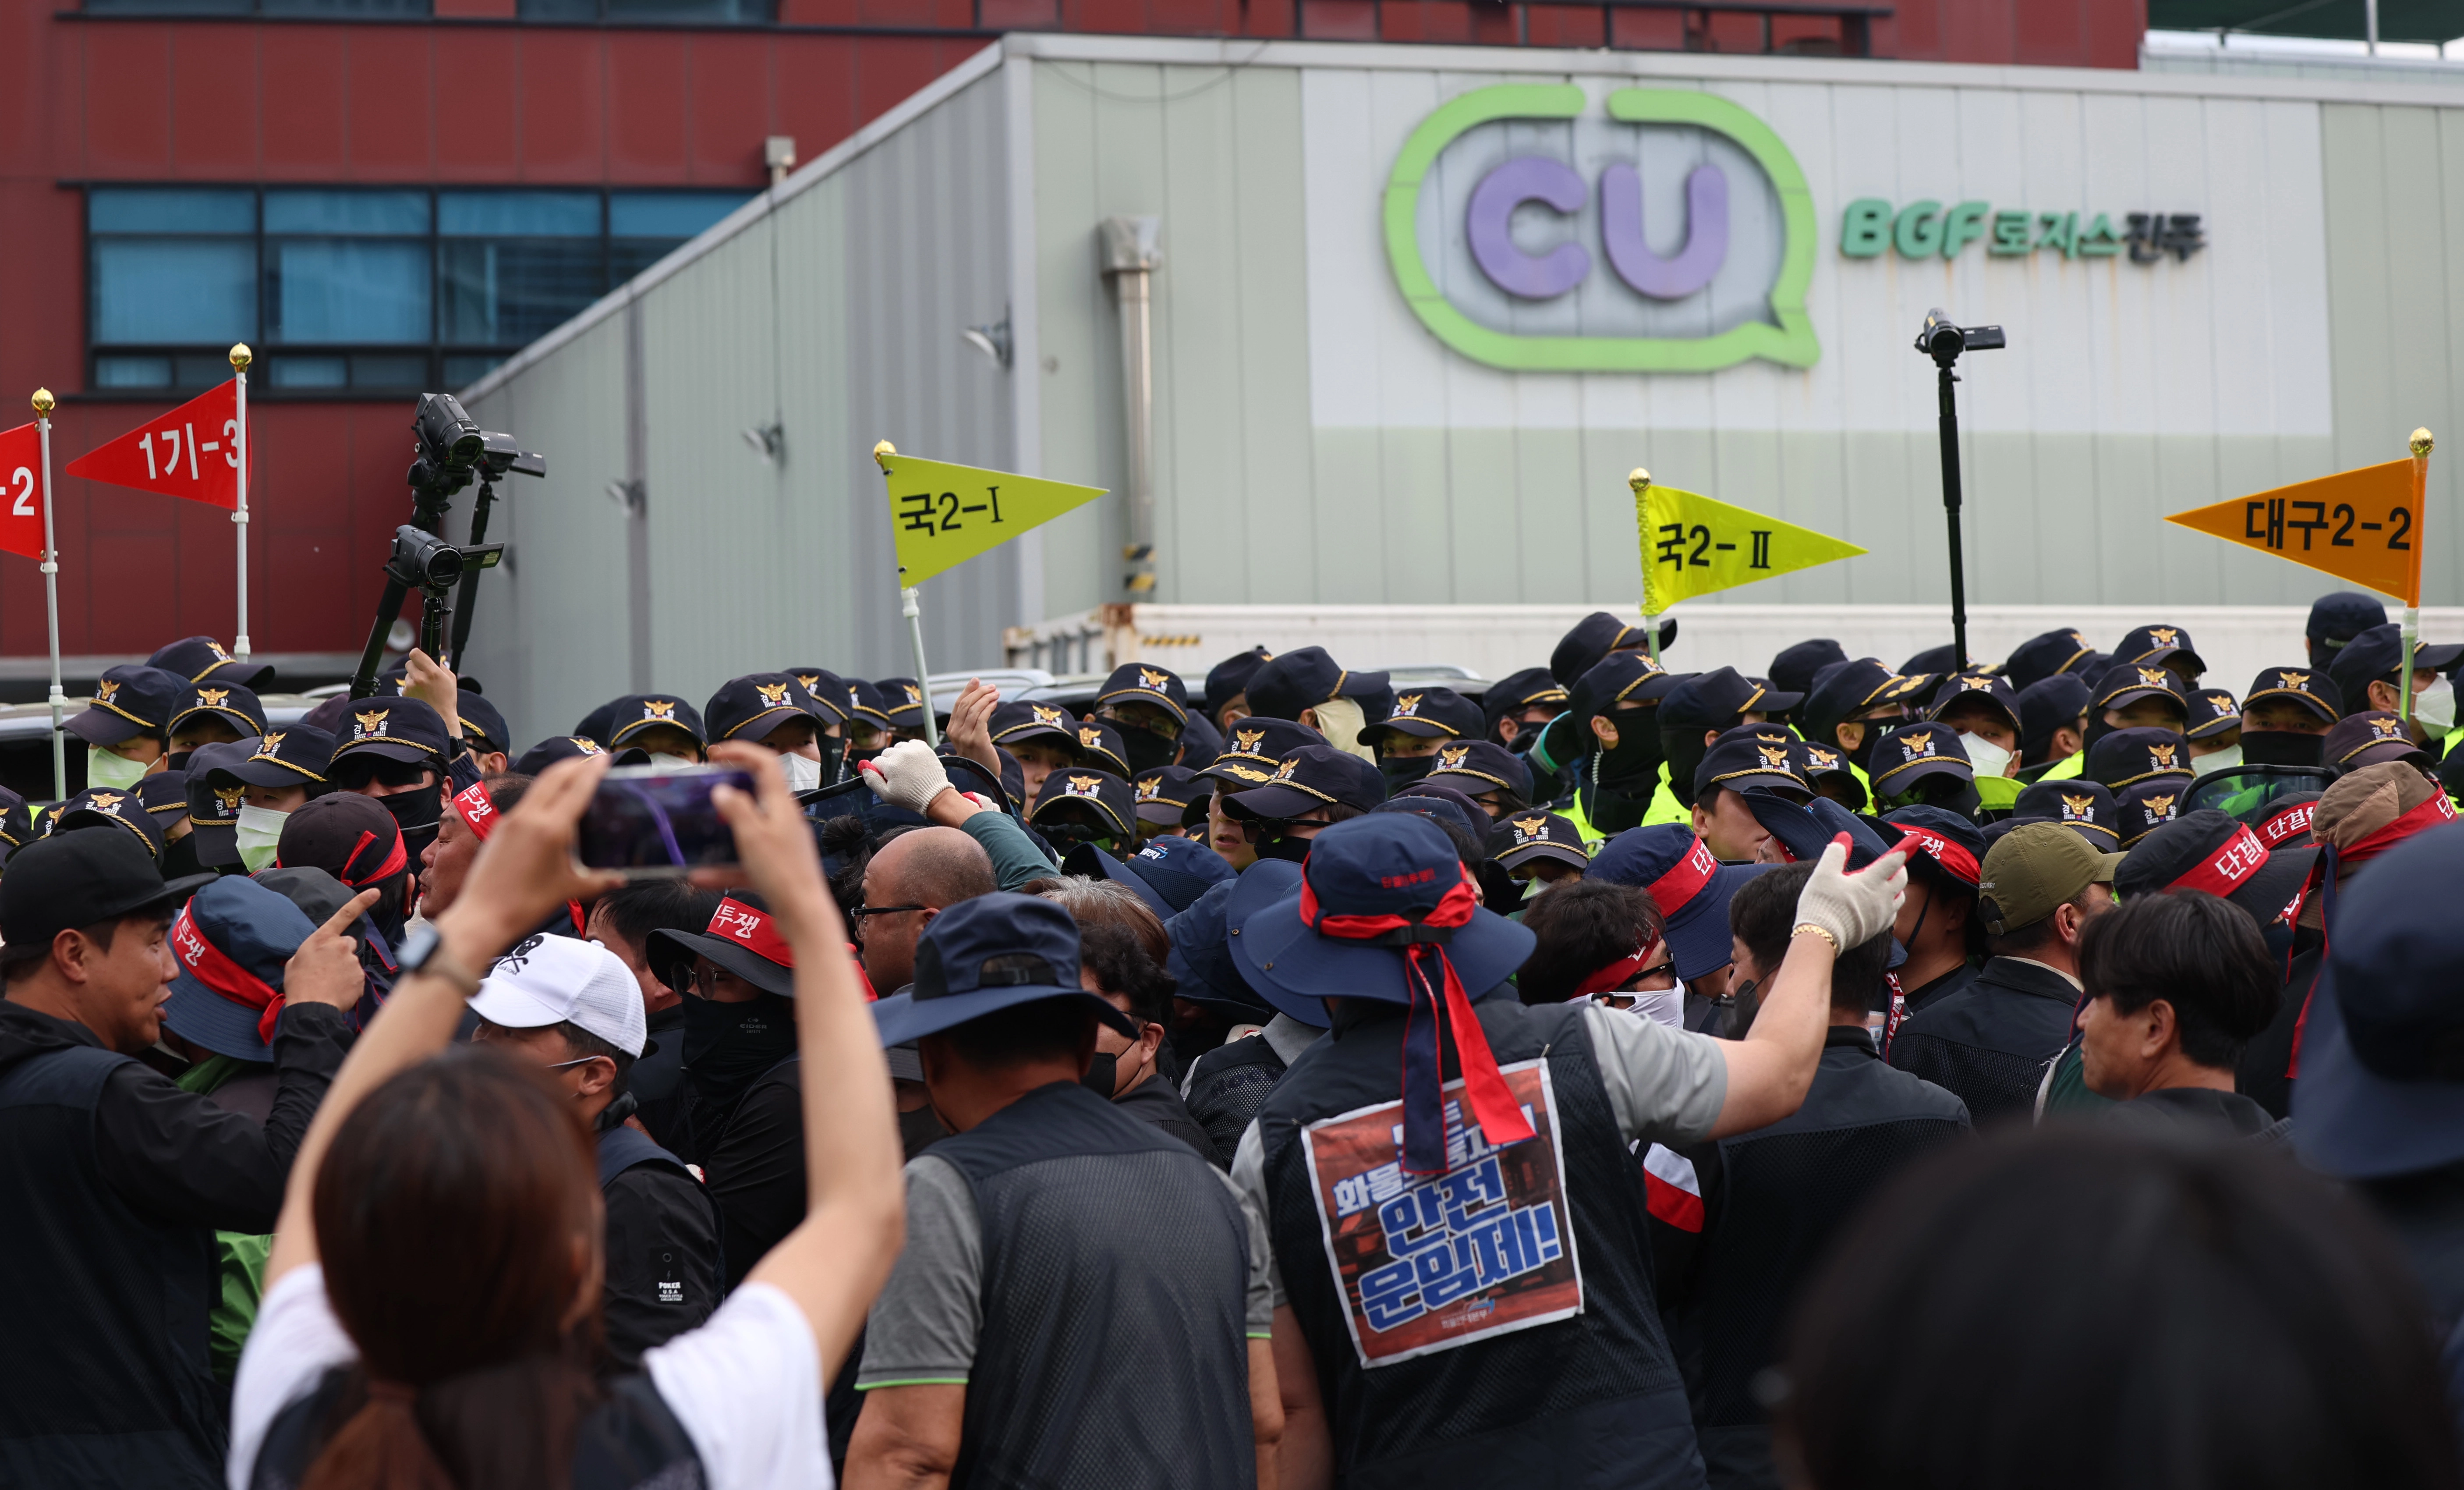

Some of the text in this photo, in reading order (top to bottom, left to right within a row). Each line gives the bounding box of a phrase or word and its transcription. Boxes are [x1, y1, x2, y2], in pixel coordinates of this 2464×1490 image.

[1466, 156, 1729, 301] CU
[139, 419, 237, 480] 1기-3
[2246, 498, 2411, 551] 대구2-2
[196, 698, 228, 706] 경찰
[761, 692, 791, 703] 경찰
[354, 721, 388, 734] 경찰
[256, 743, 280, 754] 경찰
[1232, 741, 1261, 752] 경찰
[1902, 741, 1935, 756] 경찰
[1437, 756, 1466, 767] 경찰
[1759, 756, 1790, 769] 경찰
[1809, 754, 1838, 767] 경찰
[2150, 755, 2179, 766] 경찰
[1066, 783, 1100, 795] 경찰
[85, 801, 122, 811] 경찰
[459, 786, 492, 823] 투쟁
[2063, 804, 2095, 817] 경찰
[2436, 792, 2454, 820] 단
[2144, 805, 2177, 819] 경찰
[1514, 827, 1549, 839] 경찰
[717, 905, 761, 939] 투쟁
[176, 918, 206, 967] 투쟁
[1378, 1155, 1508, 1261] 안전
[1358, 1200, 1563, 1333] 운임제!
